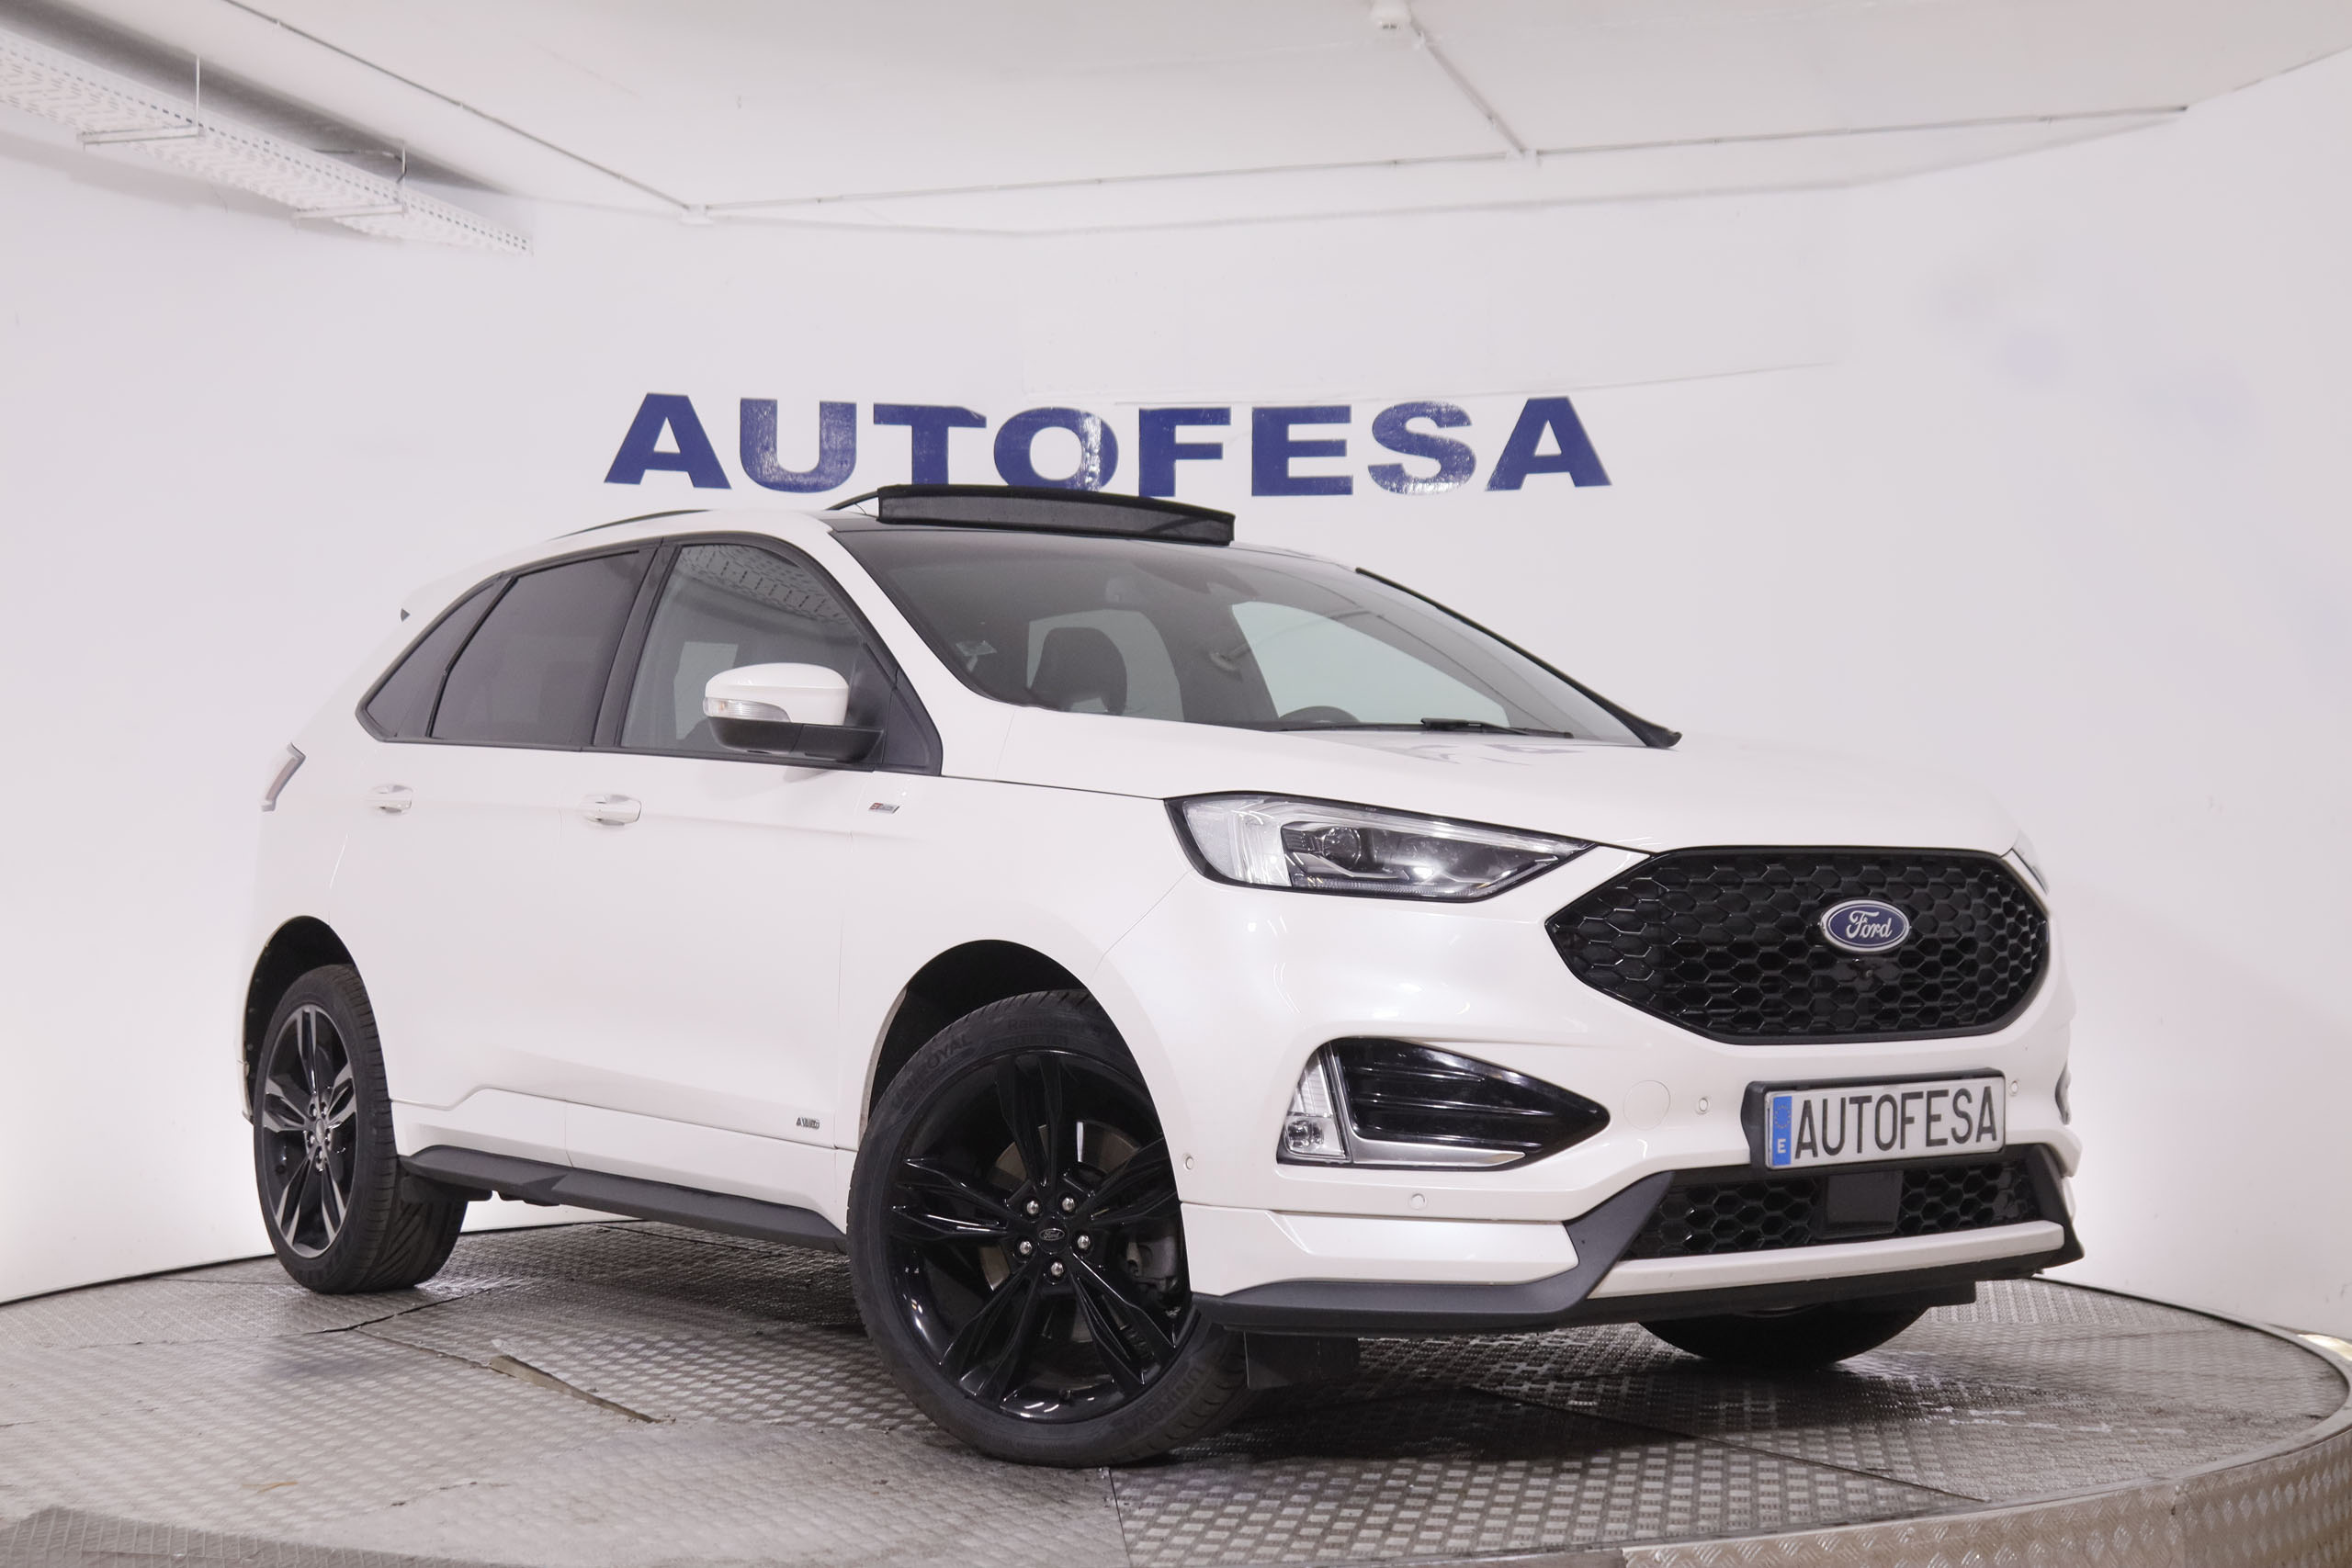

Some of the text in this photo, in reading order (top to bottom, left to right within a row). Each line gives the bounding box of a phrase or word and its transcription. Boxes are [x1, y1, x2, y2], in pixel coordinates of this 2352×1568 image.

[604, 392, 1613, 497] AUTOFESA
[1846, 909, 1893, 939] Ford
[1777, 1085, 1997, 1160] E AUTOFESA
